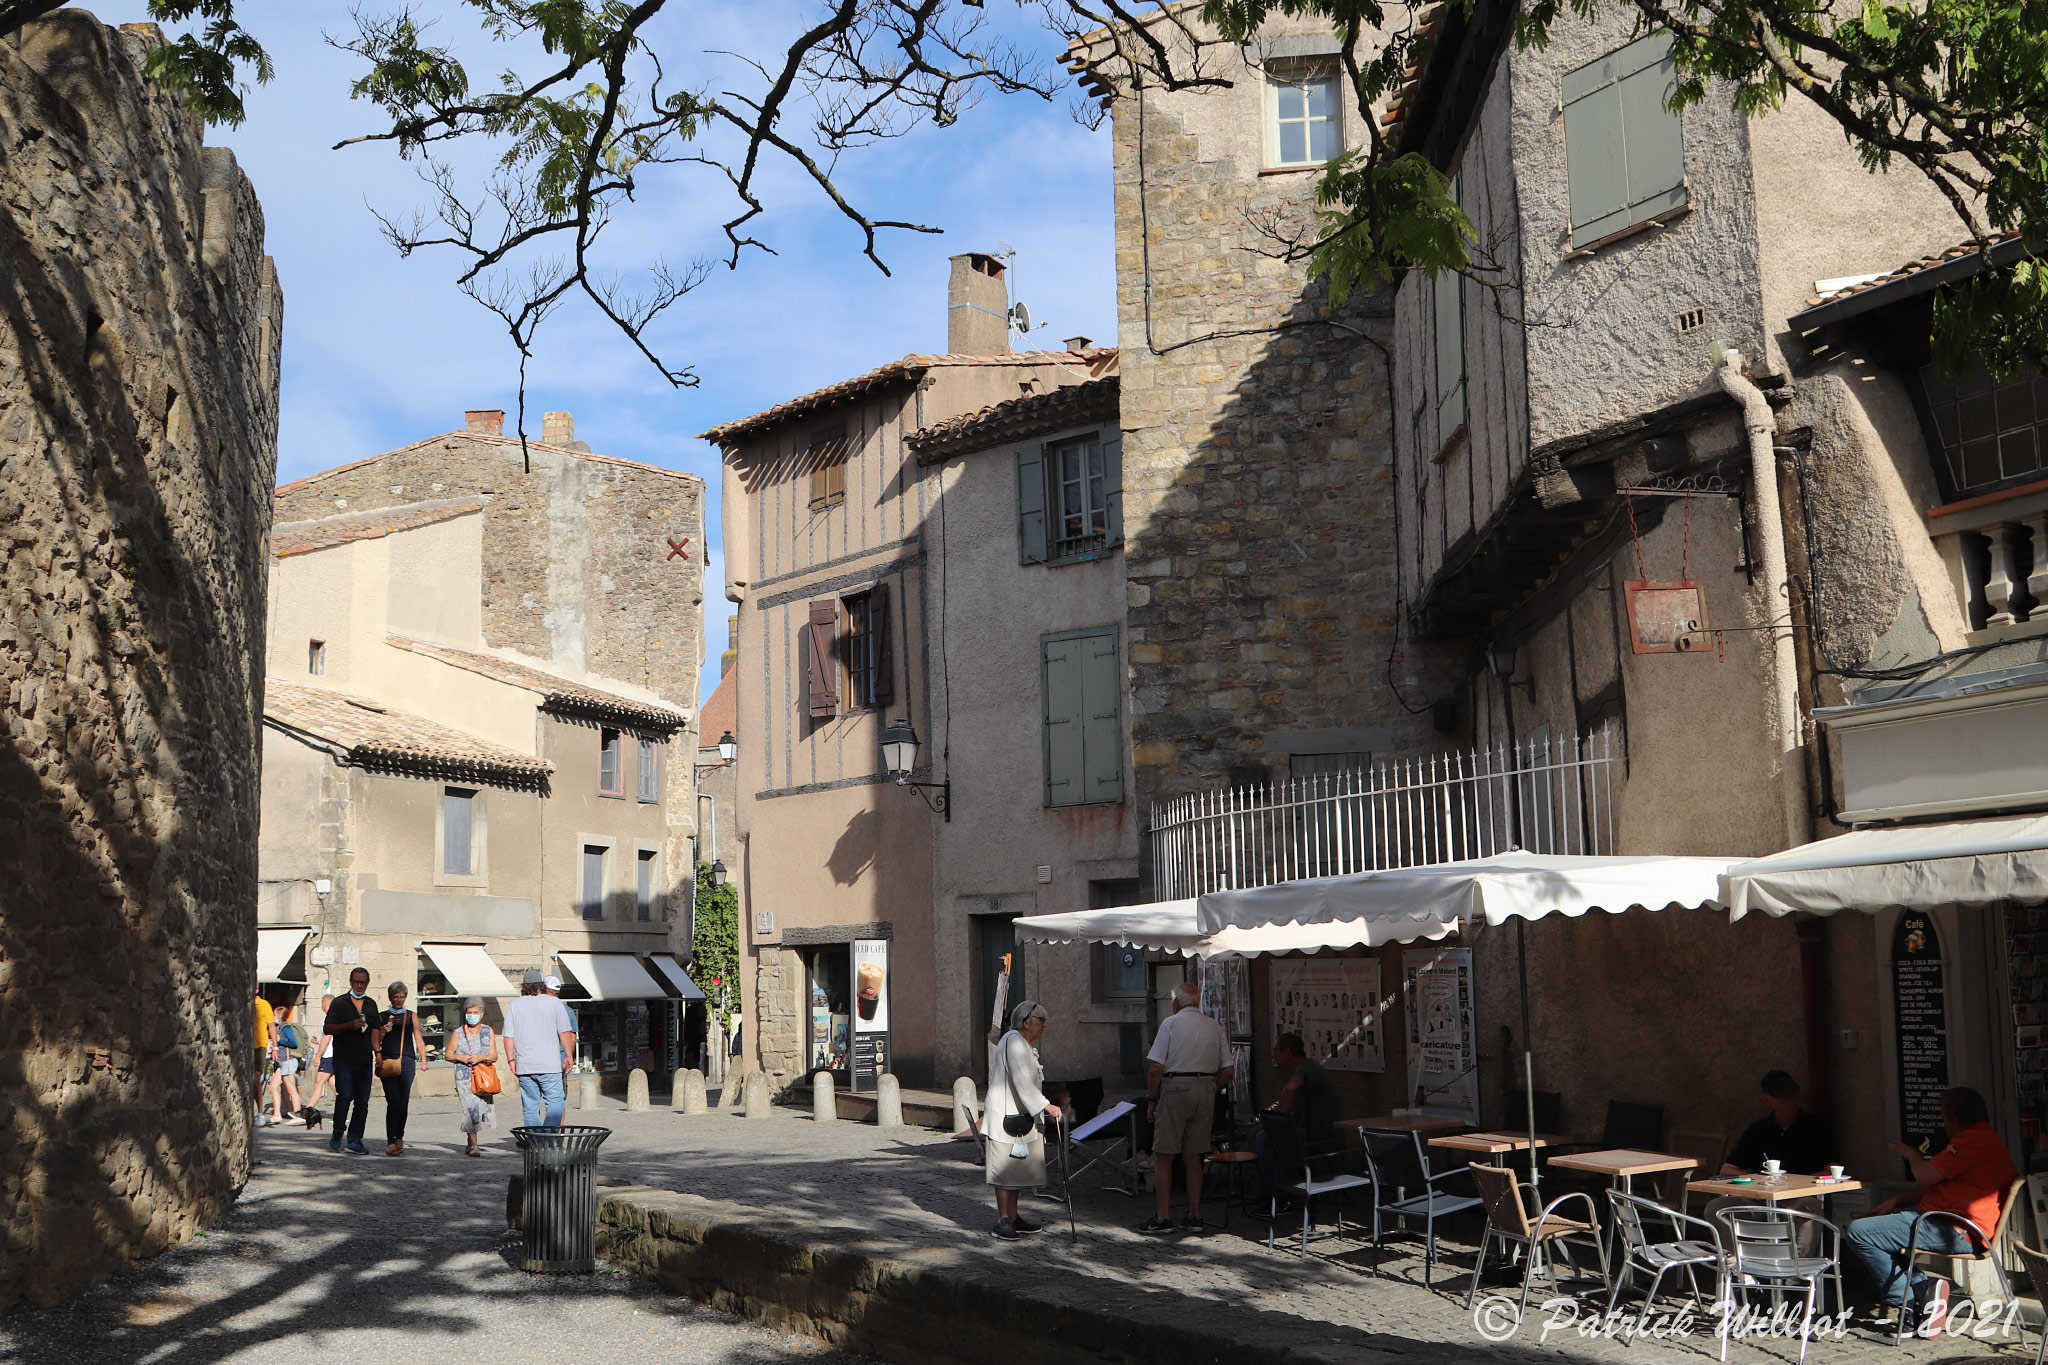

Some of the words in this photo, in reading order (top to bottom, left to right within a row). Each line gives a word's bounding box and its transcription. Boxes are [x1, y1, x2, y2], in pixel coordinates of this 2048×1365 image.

[1905, 919, 1925, 929] Café
[855, 944, 869, 954] ICED
[870, 942, 886, 954] CAFÉ
[1420, 1041, 1461, 1050] caricature
